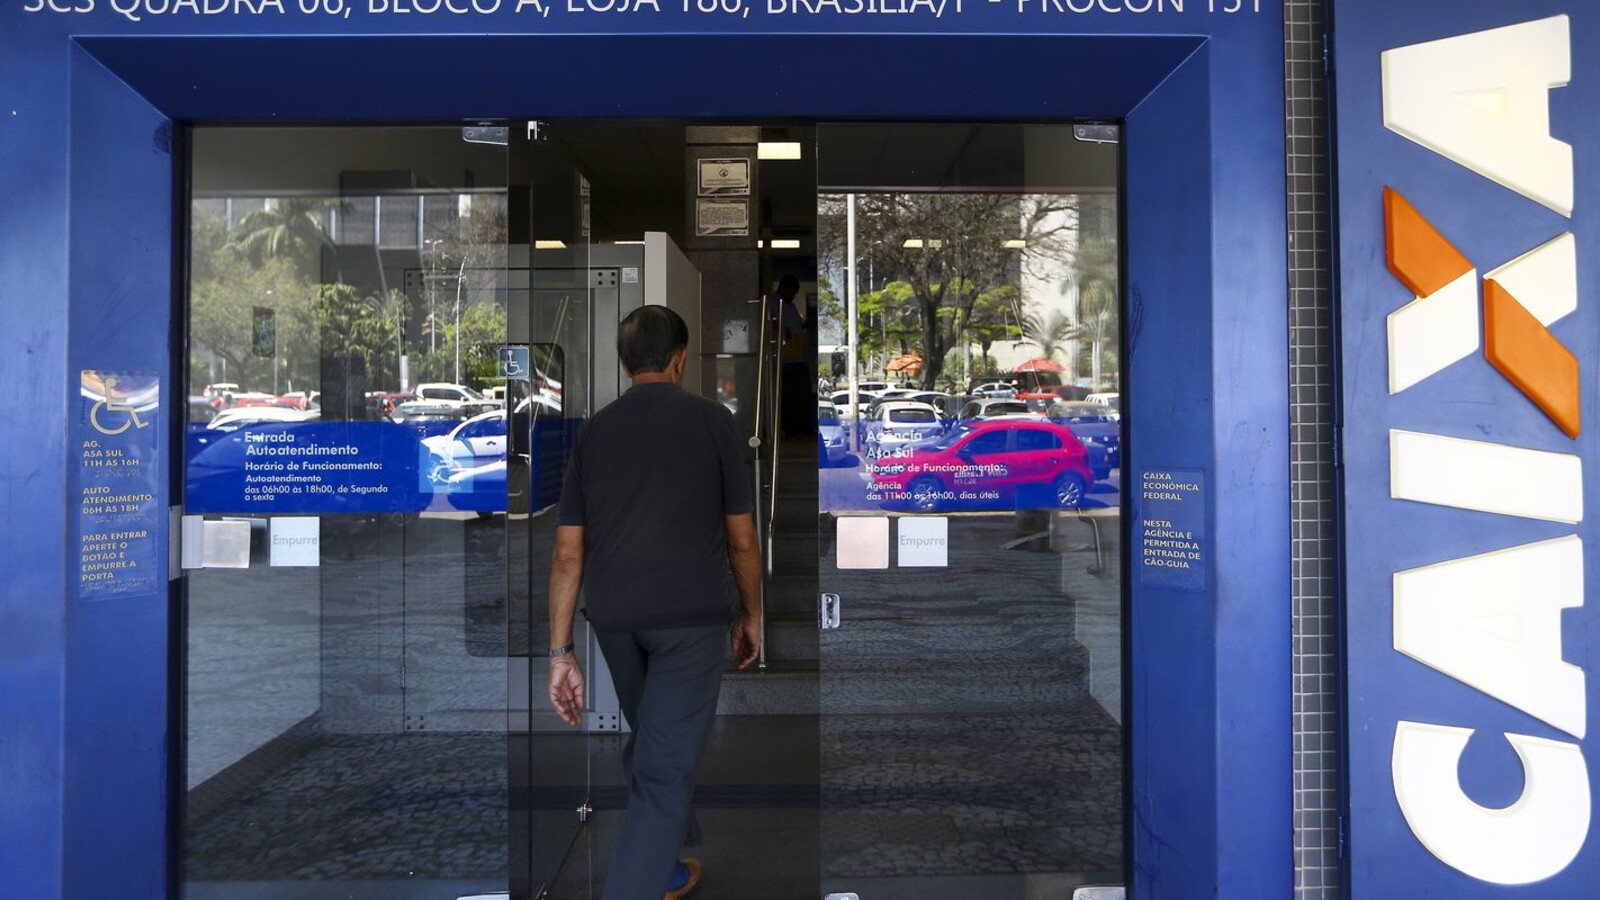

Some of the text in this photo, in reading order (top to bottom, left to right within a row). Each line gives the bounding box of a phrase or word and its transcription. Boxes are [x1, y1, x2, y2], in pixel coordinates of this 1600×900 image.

[244, 431, 295, 443] Entrada
[866, 429, 923, 442] Ancia
[83, 440, 101, 448] AG.
[106, 449, 123, 457] SUL
[245, 444, 359, 456] Autoatendimento
[866, 447, 914, 459] Asa Sul
[1381, 14, 1592, 885] CAIXA
[245, 461, 383, 471] Horário de Funcionamento:
[865, 463, 1004, 473] Horário de Funcionamento:
[245, 475, 322, 483] Autoatendimento
[1143, 472, 1172, 480] CAIXA
[83, 486, 110, 494] AUTO
[244, 486, 260, 494] das
[262, 485, 290, 494] 06h00
[305, 485, 335, 495] 18h00,
[337, 485, 349, 493] de
[350, 484, 388, 495] Segunda
[866, 481, 902, 491] Agência
[1143, 481, 1199, 491] ECONÔMICA
[83, 494, 152, 504] ATENDIMENTO
[866, 492, 881, 500] das
[885, 491, 911, 500] 11h00
[959, 491, 977, 499] dias
[979, 490, 999, 499] úteis
[1143, 492, 1182, 500] FEDERAL
[83, 506, 102, 514] 06H
[121, 504, 139, 512] 18H
[1143, 520, 1172, 528] NESTA
[82, 531, 147, 542] PARA ENTRAR
[1144, 529, 1185, 539] AGÊNCIA
[273, 534, 318, 548] Empurre
[900, 535, 945, 549] Empurre
[1143, 539, 1199, 550] PERMITIDA A
[82, 541, 128, 552] APERTE O
[1143, 549, 1200, 560] ENTRADA DE
[82, 561, 127, 572] EMPURRE
[1144, 557, 1189, 569] CÃO-GUIA
[82, 572, 114, 581] PORTA
